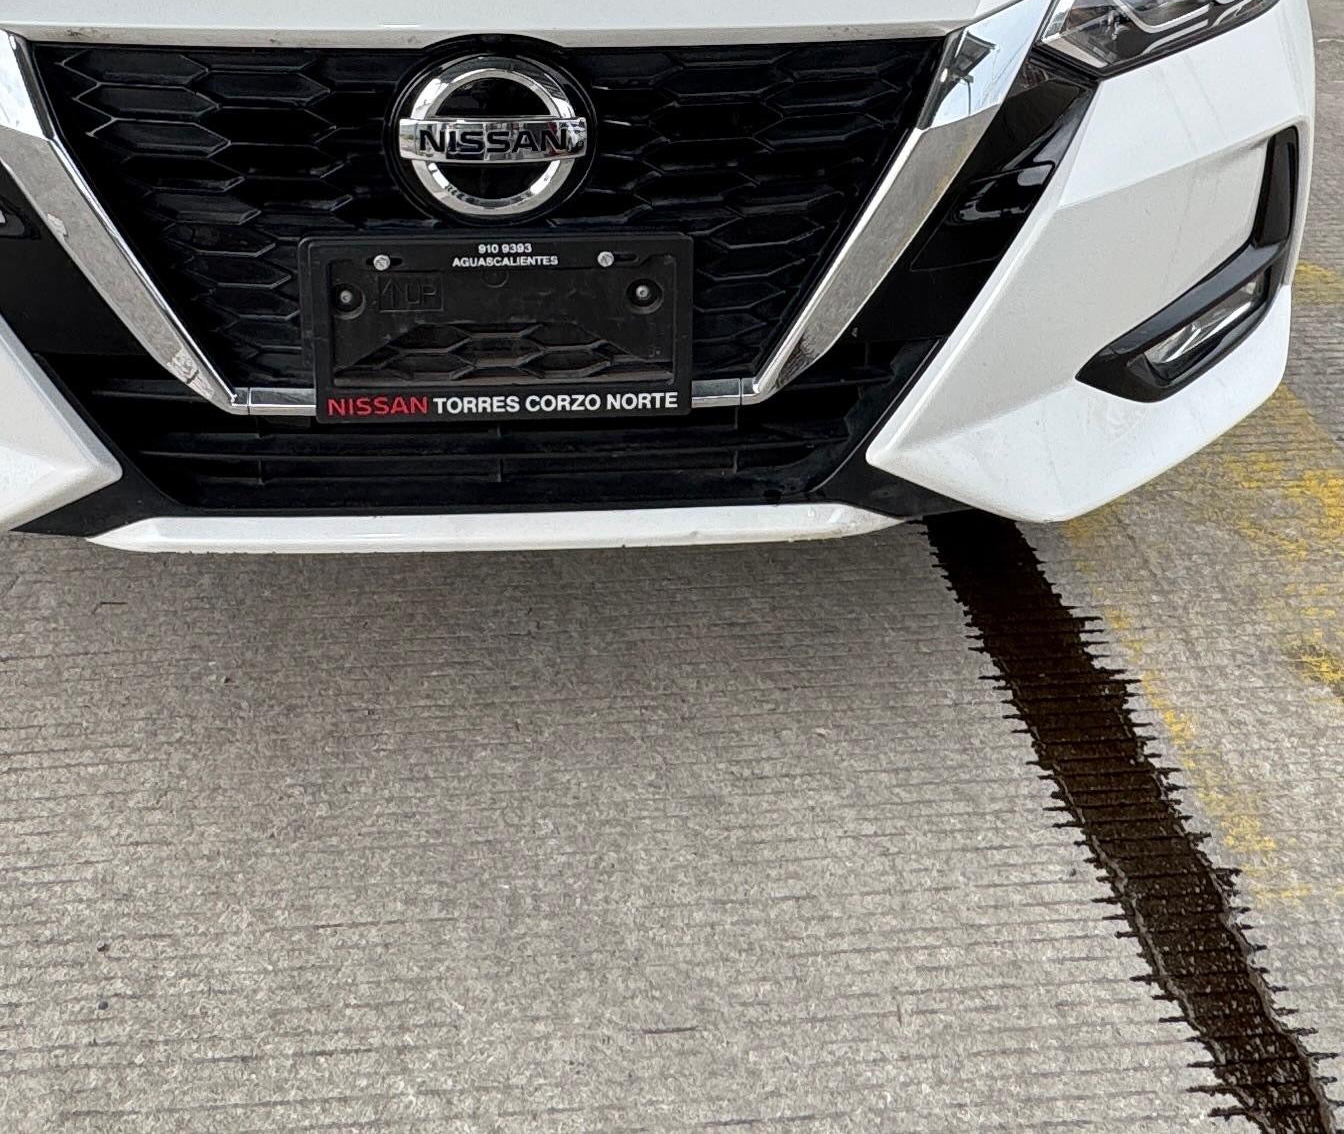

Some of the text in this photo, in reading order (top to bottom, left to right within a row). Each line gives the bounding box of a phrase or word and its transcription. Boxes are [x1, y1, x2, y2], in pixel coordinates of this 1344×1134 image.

[419, 127, 567, 154] NISSAN
[452, 255, 559, 268] AGUASCALIENTES
[327, 392, 679, 417] NISSAN TORRES CORZO NORTE
